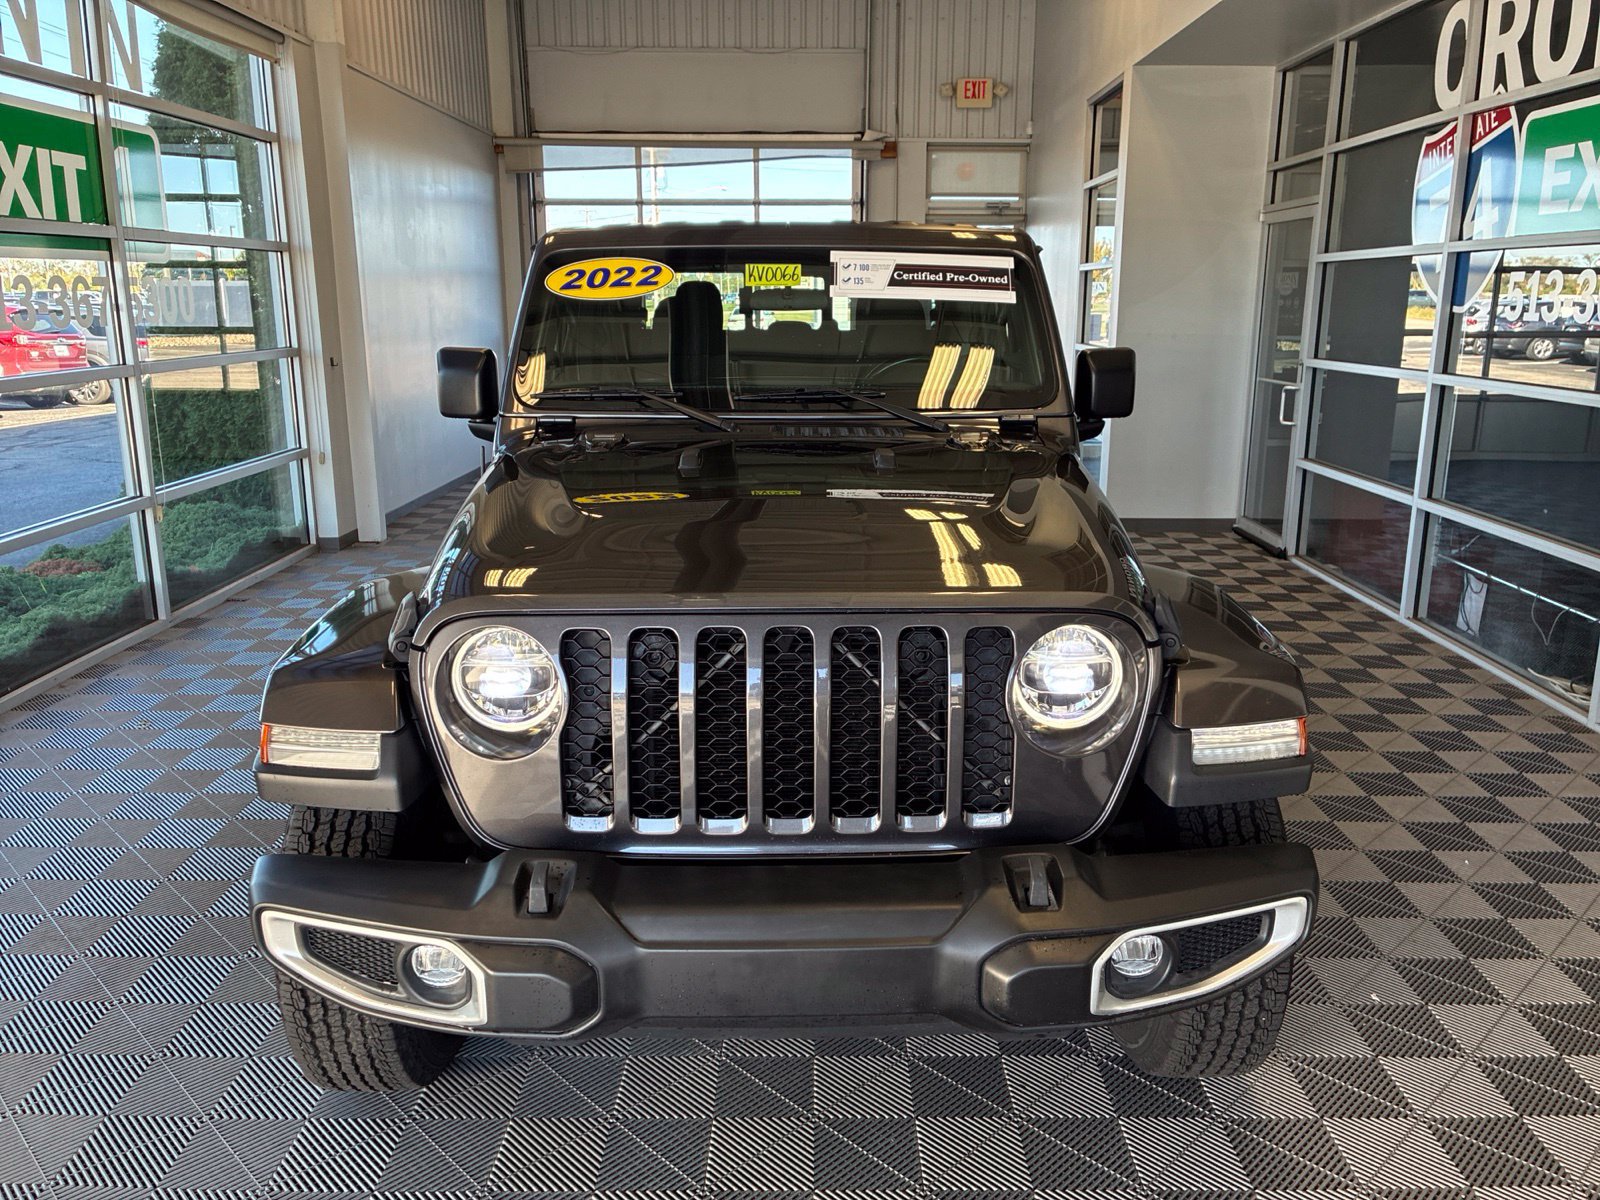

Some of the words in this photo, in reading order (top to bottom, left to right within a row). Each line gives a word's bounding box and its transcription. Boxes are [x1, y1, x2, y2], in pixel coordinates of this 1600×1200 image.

[1435, 0, 1600, 111] CRO
[964, 80, 987, 99] EXIT
[1428, 111, 1499, 171] INTEATE
[559, 265, 663, 290] 2022
[893, 271, 943, 281] Certified
[946, 273, 1008, 284] Pre-Owned
[1504, 268, 1600, 325] 513-3
